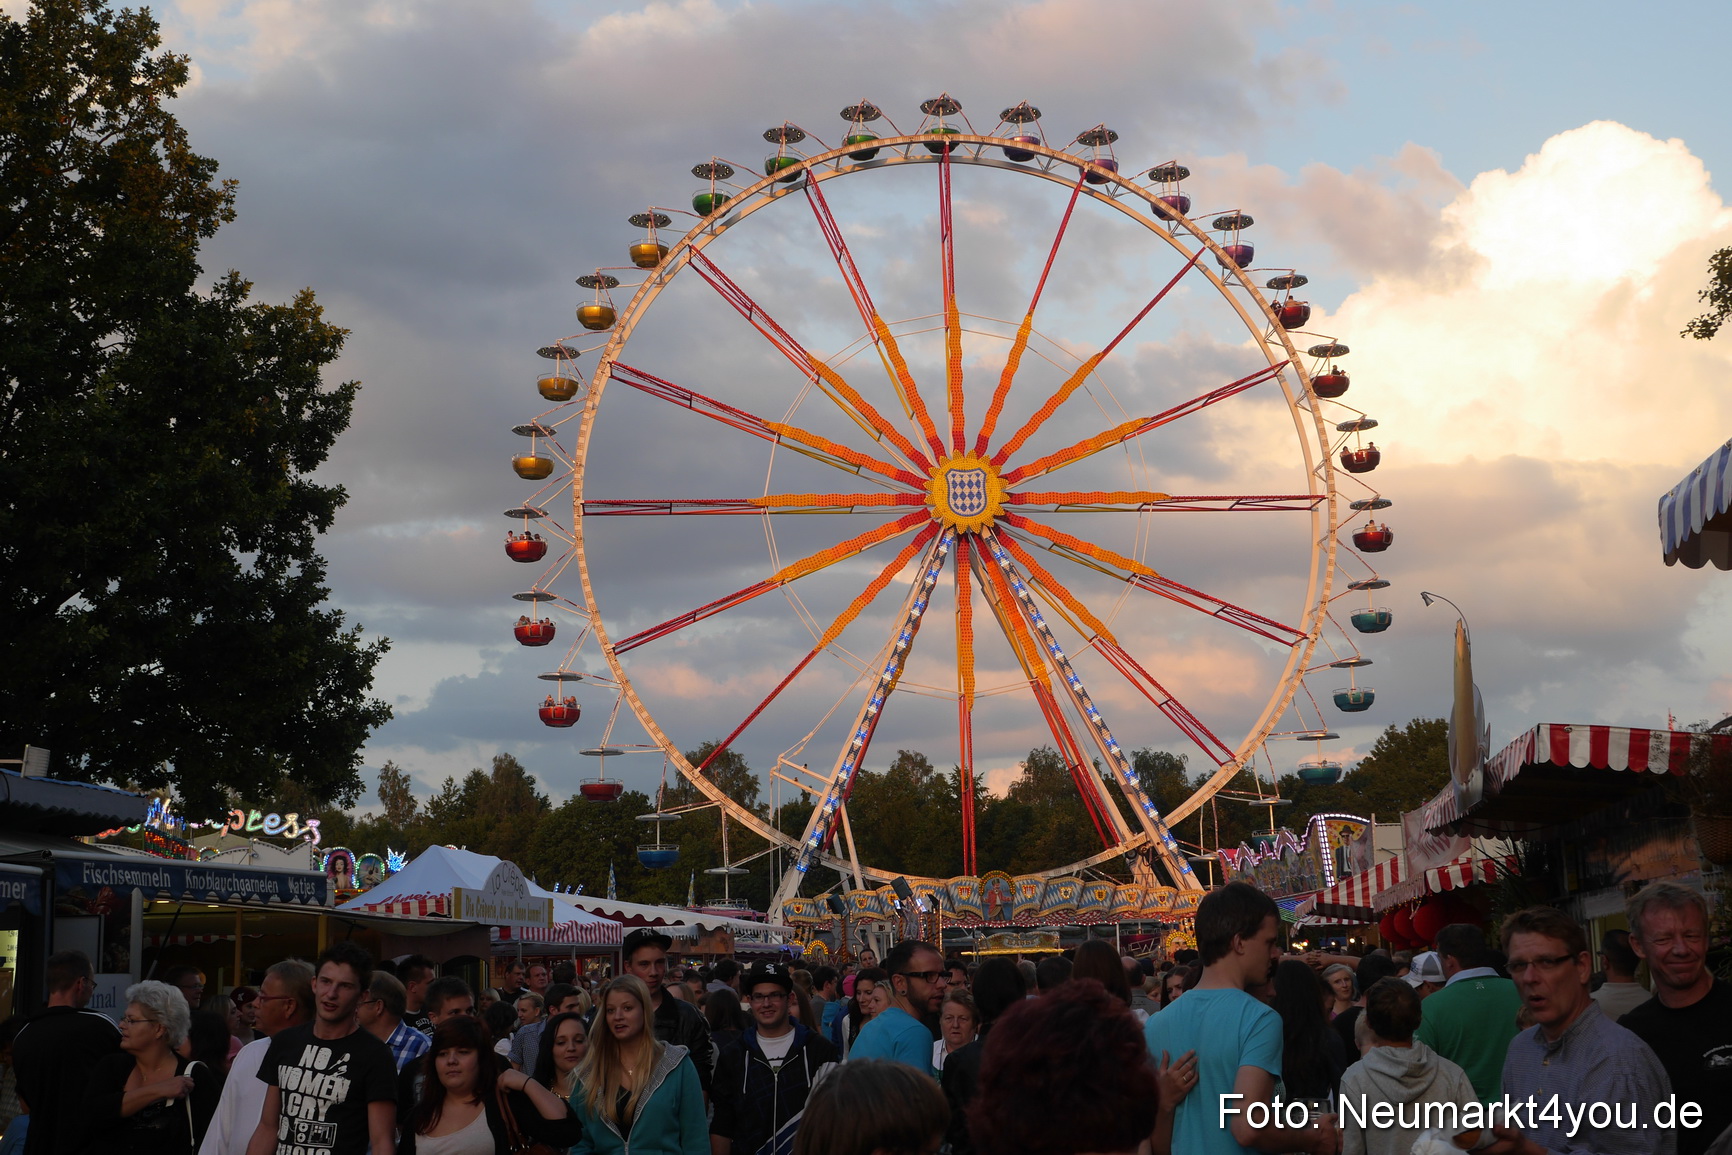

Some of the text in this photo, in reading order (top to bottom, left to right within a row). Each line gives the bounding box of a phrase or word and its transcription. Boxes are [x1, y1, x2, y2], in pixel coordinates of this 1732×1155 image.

[83, 862, 316, 899] Fischsemmeln Knoblauchgarnelen Matjes
[298, 1043, 333, 1072] NO
[277, 1064, 352, 1105] WOMEN
[287, 1092, 333, 1122] CRY
